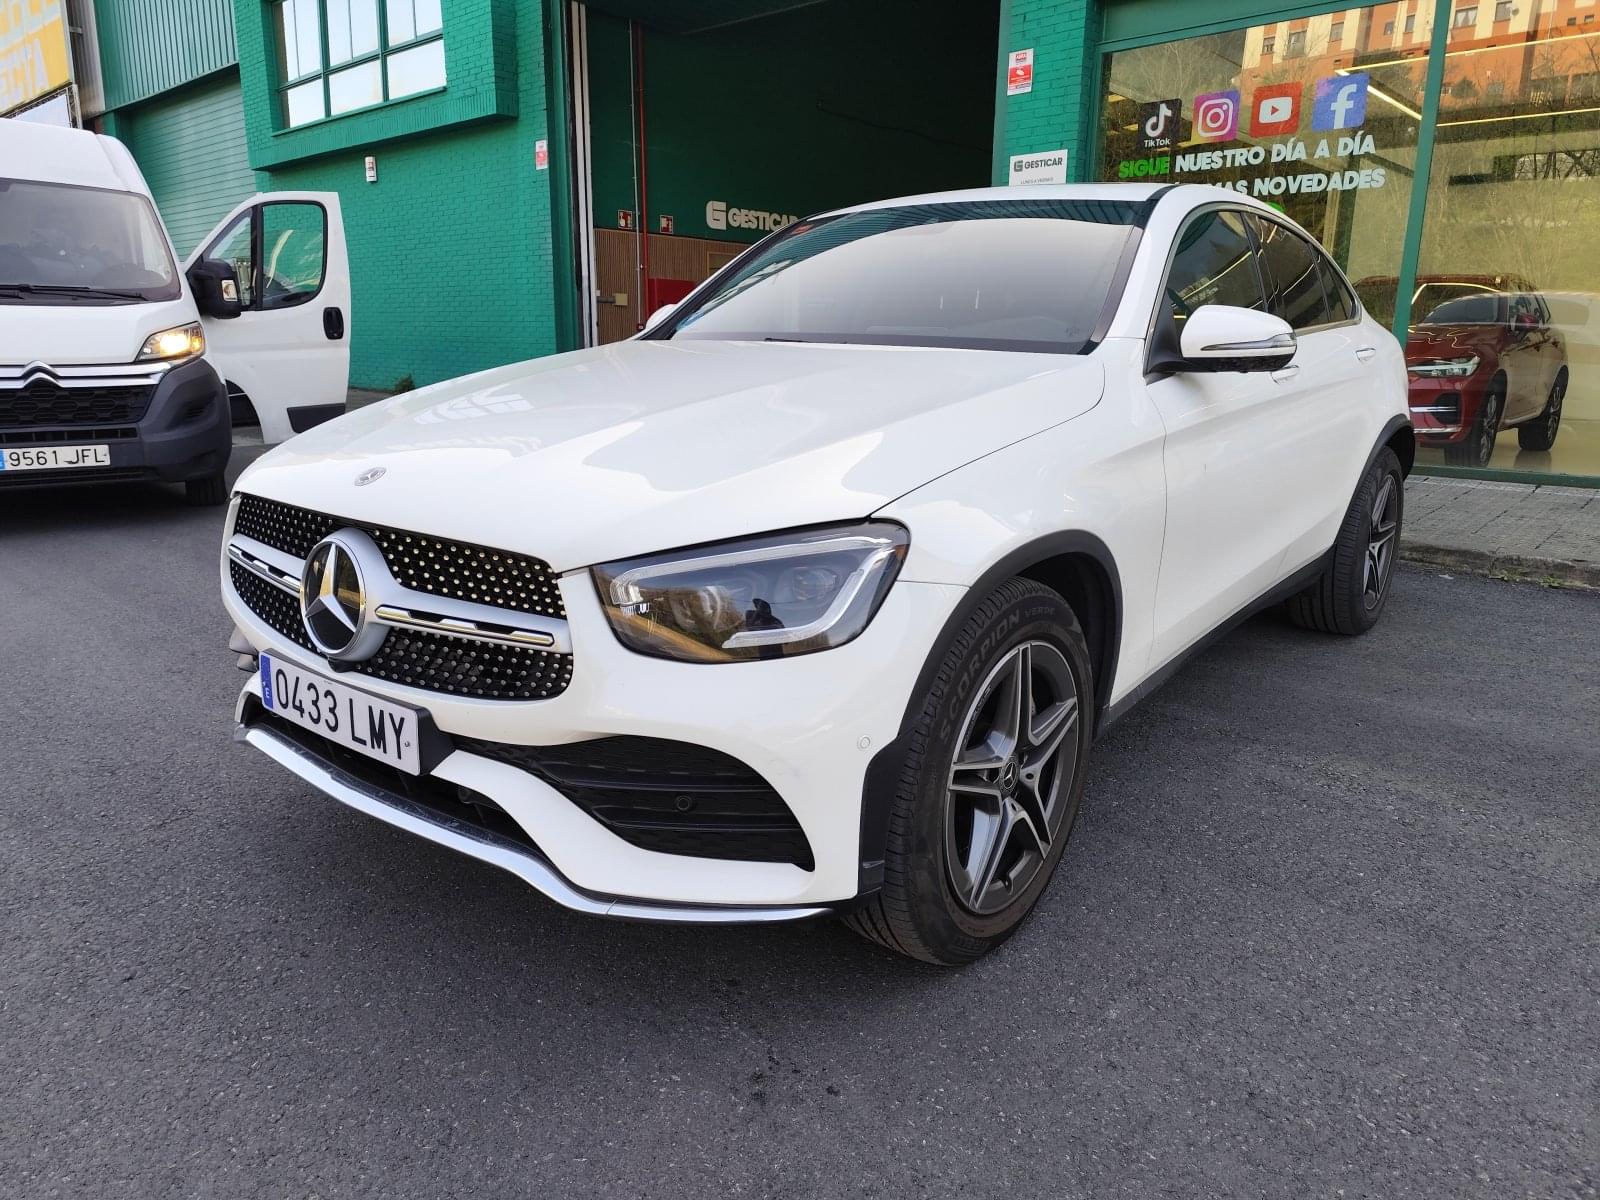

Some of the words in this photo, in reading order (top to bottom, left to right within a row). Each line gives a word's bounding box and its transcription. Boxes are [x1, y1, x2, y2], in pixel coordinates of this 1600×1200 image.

[1118, 156, 1170, 179] SIGUE
[1175, 147, 1266, 173] NUESTRO
[1270, 138, 1307, 163] DÍA
[1313, 139, 1331, 159] A
[1337, 130, 1376, 155] DÍA
[1144, 137, 1171, 148] TikTok
[1024, 157, 1063, 170] GESTICAR
[1253, 168, 1386, 197] NOVEDADES
[9, 450, 58, 467] 9561
[64, 448, 105, 465] JFL
[1024, 605, 1056, 618] VERDE
[940, 609, 1020, 743] SCORPION
[275, 668, 339, 733] 0433
[349, 698, 405, 760] LMY
